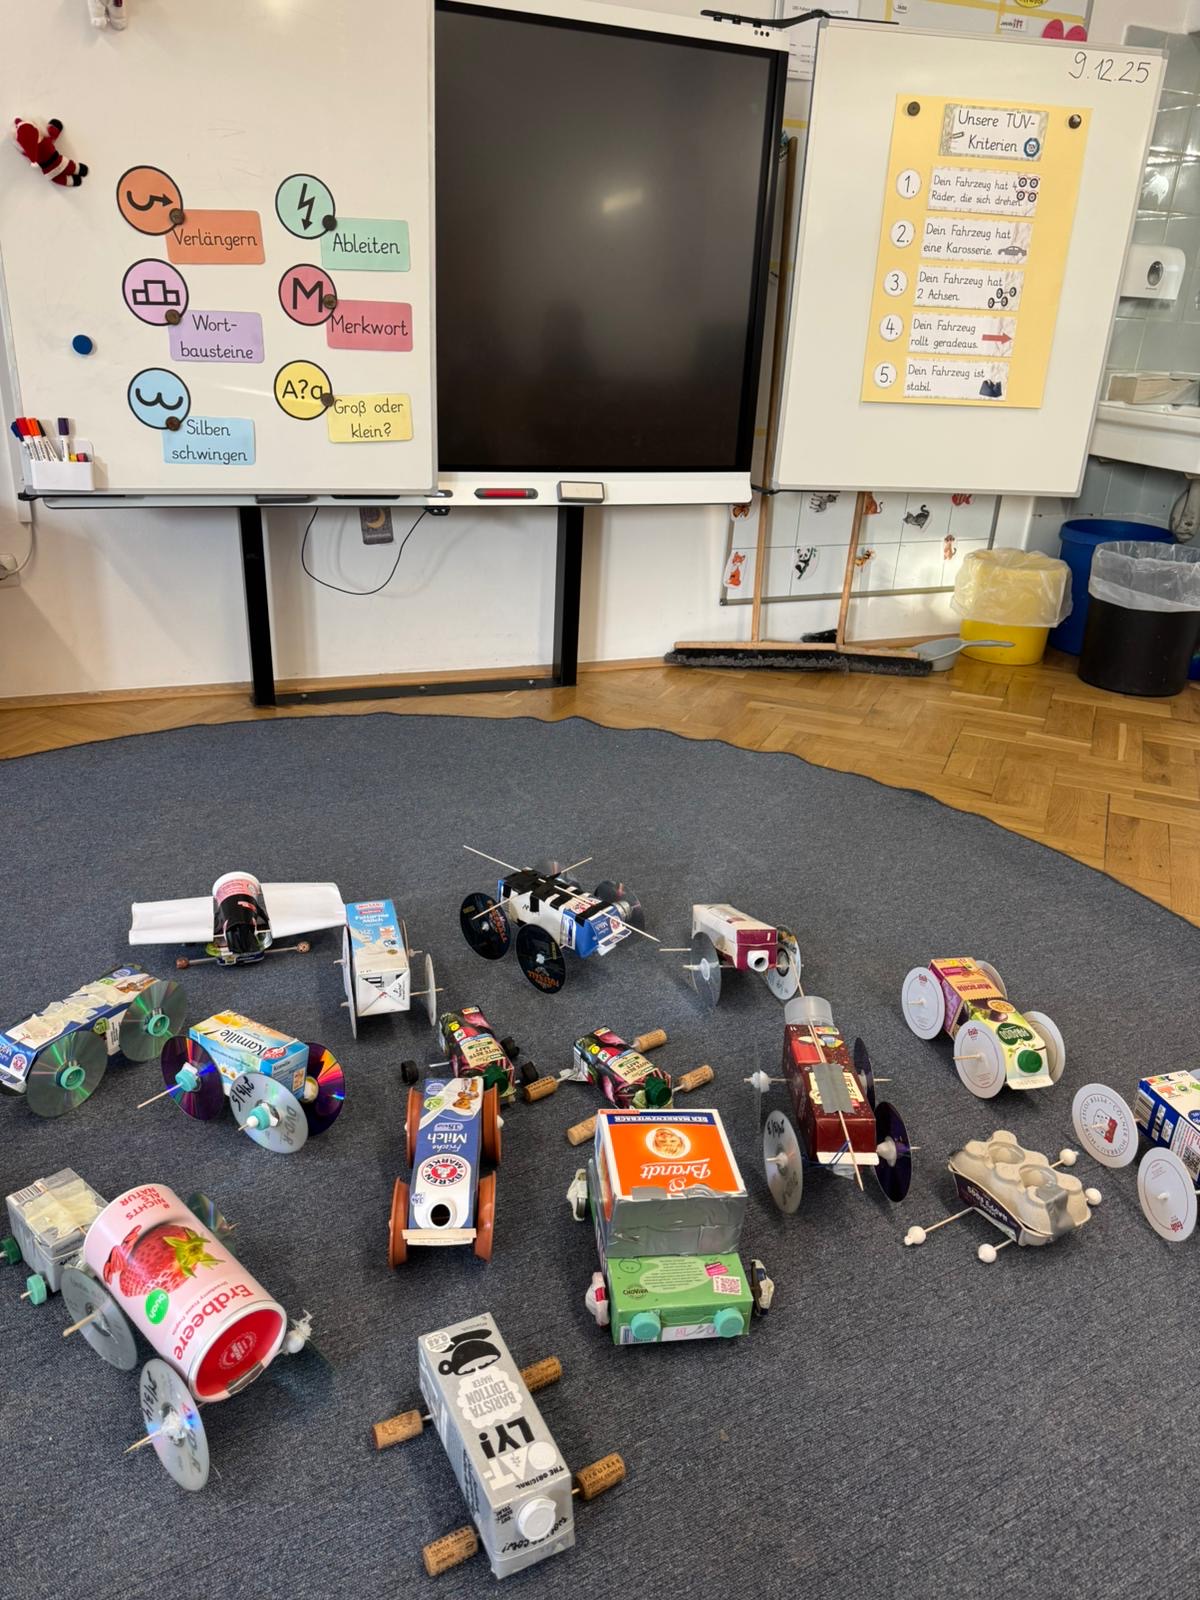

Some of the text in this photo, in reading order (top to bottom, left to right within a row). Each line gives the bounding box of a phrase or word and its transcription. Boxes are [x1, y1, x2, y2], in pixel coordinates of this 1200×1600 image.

[1069, 51, 1151, 83] 9.12.25
[958, 110, 1036, 129] Unsere TÜV-
[968, 134, 1017, 152] Kriterien
[905, 175, 915, 194] 1.
[933, 175, 951, 186] Dein
[955, 176, 991, 191] Fahrzeug
[994, 181, 1008, 190] hat
[960, 193, 972, 203] die
[976, 195, 991, 204] sich
[172, 229, 257, 250] Verlängern
[896, 224, 909, 243] 2.
[926, 223, 1011, 240] Dein Fahrzeug hat
[332, 233, 400, 254] Ableiten
[923, 242, 993, 255] eine Karosserie.
[890, 273, 903, 292] 3.
[919, 271, 1003, 288] Dein Fahrzeug hat
[292, 277, 324, 312] M
[917, 288, 960, 301] 2 Achsen.
[192, 314, 237, 332] Wort-
[330, 314, 409, 336] Merkwort
[885, 318, 898, 336] 4.
[913, 318, 976, 335] Dein Fahrzeug
[180, 341, 254, 359] bausteine
[911, 336, 978, 349] rollt geradeaus.
[879, 366, 892, 384] 5.
[908, 364, 985, 379] Dein Fahrzeug ist
[906, 381, 932, 392] stabil.
[333, 399, 404, 417] Groß oder
[186, 419, 231, 437] Silben
[351, 423, 392, 439] klein?
[172, 448, 248, 465] schwingen
[219, 1028, 267, 1056] Kamille
[281, 1105, 297, 1147] DVD-R
[427, 1133, 467, 1144] Milch
[426, 1158, 464, 1170] MARKE
[641, 1161, 712, 1179] Brandt
[120, 1187, 156, 1206] NATUR
[141, 1192, 161, 1203] ALS
[126, 1197, 166, 1220] NICHTS
[173, 1284, 254, 1360] Erdbeere
[471, 1375, 494, 1388] HAFER
[465, 1381, 508, 1405] EDITION
[469, 1391, 516, 1418] BARISTA
[479, 1416, 535, 1459] LY!
[482, 1441, 557, 1490] OAT-
[516, 1465, 565, 1490] THE ORIGINAL
[502, 1539, 530, 1553] COW!
